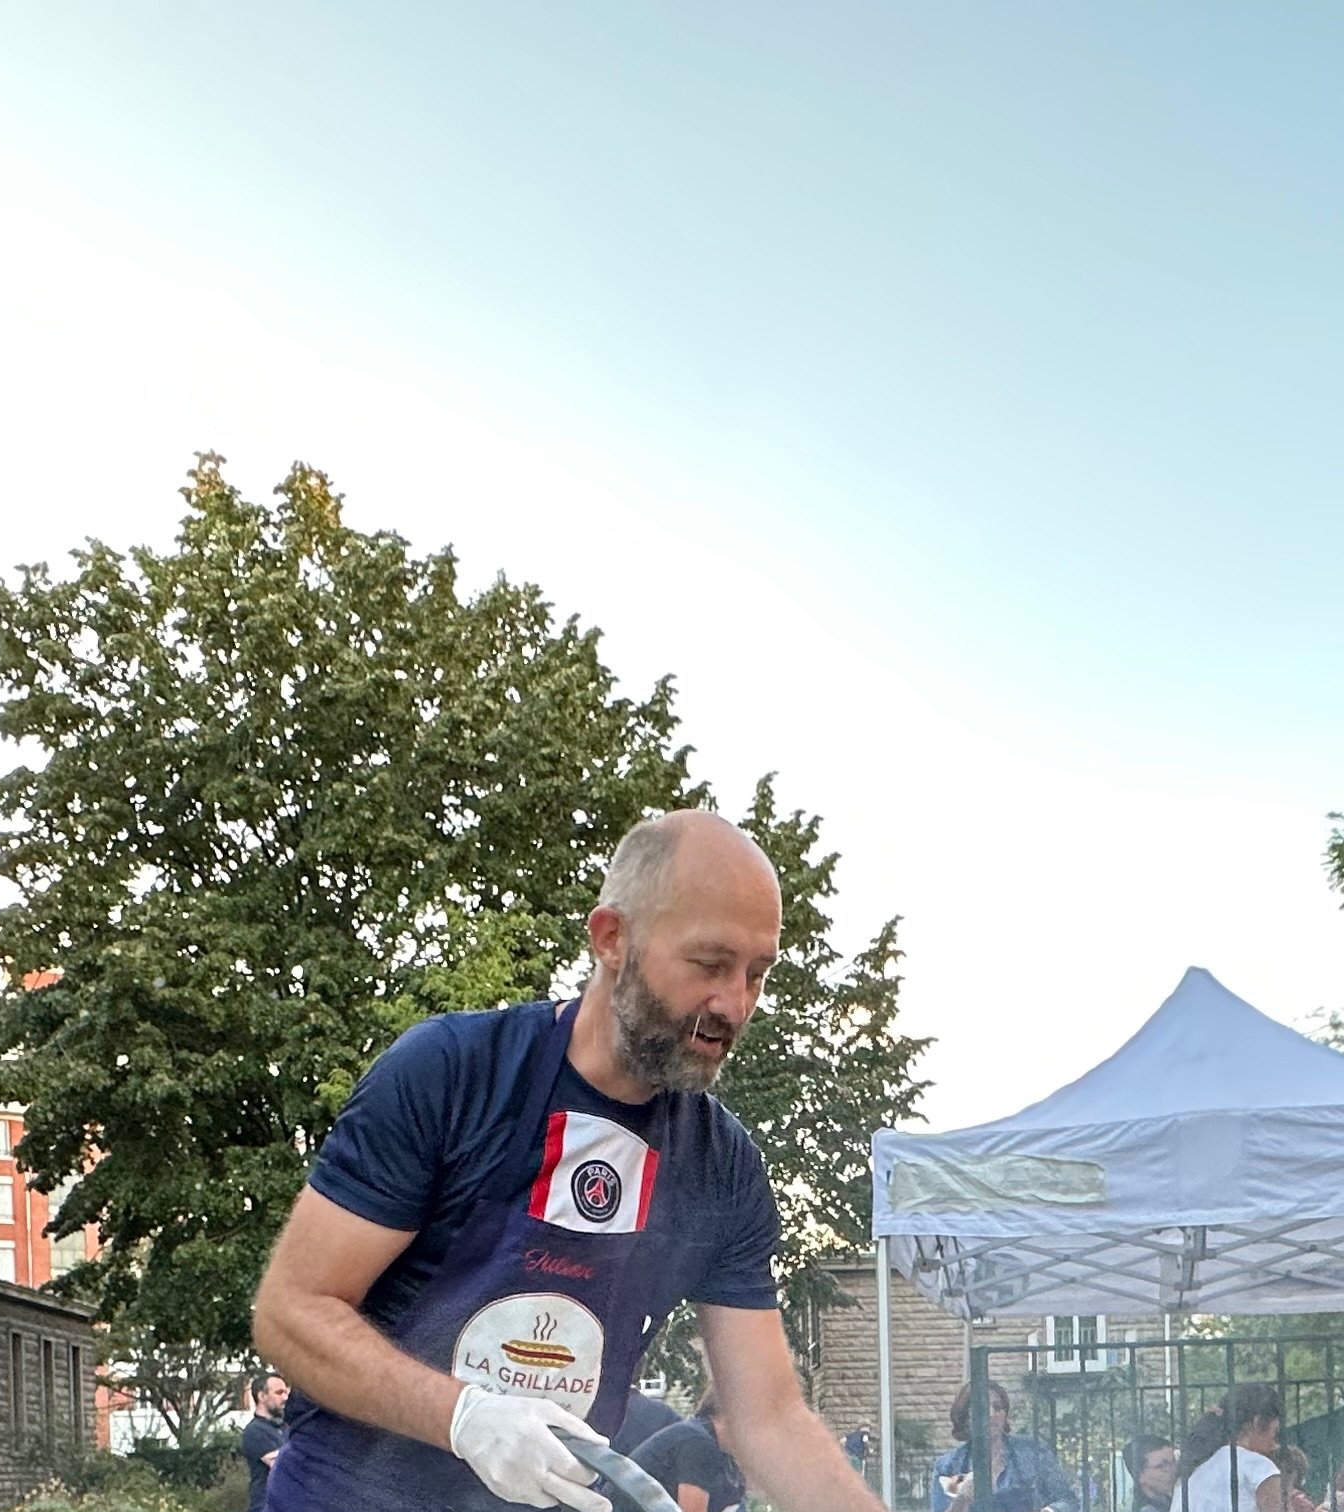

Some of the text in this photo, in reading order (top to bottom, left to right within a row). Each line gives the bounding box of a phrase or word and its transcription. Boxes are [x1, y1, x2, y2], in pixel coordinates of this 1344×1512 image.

[586, 1167, 616, 1187] PARIS
[464, 1352, 490, 1374] LA
[498, 1366, 595, 1394] GRILLADE
